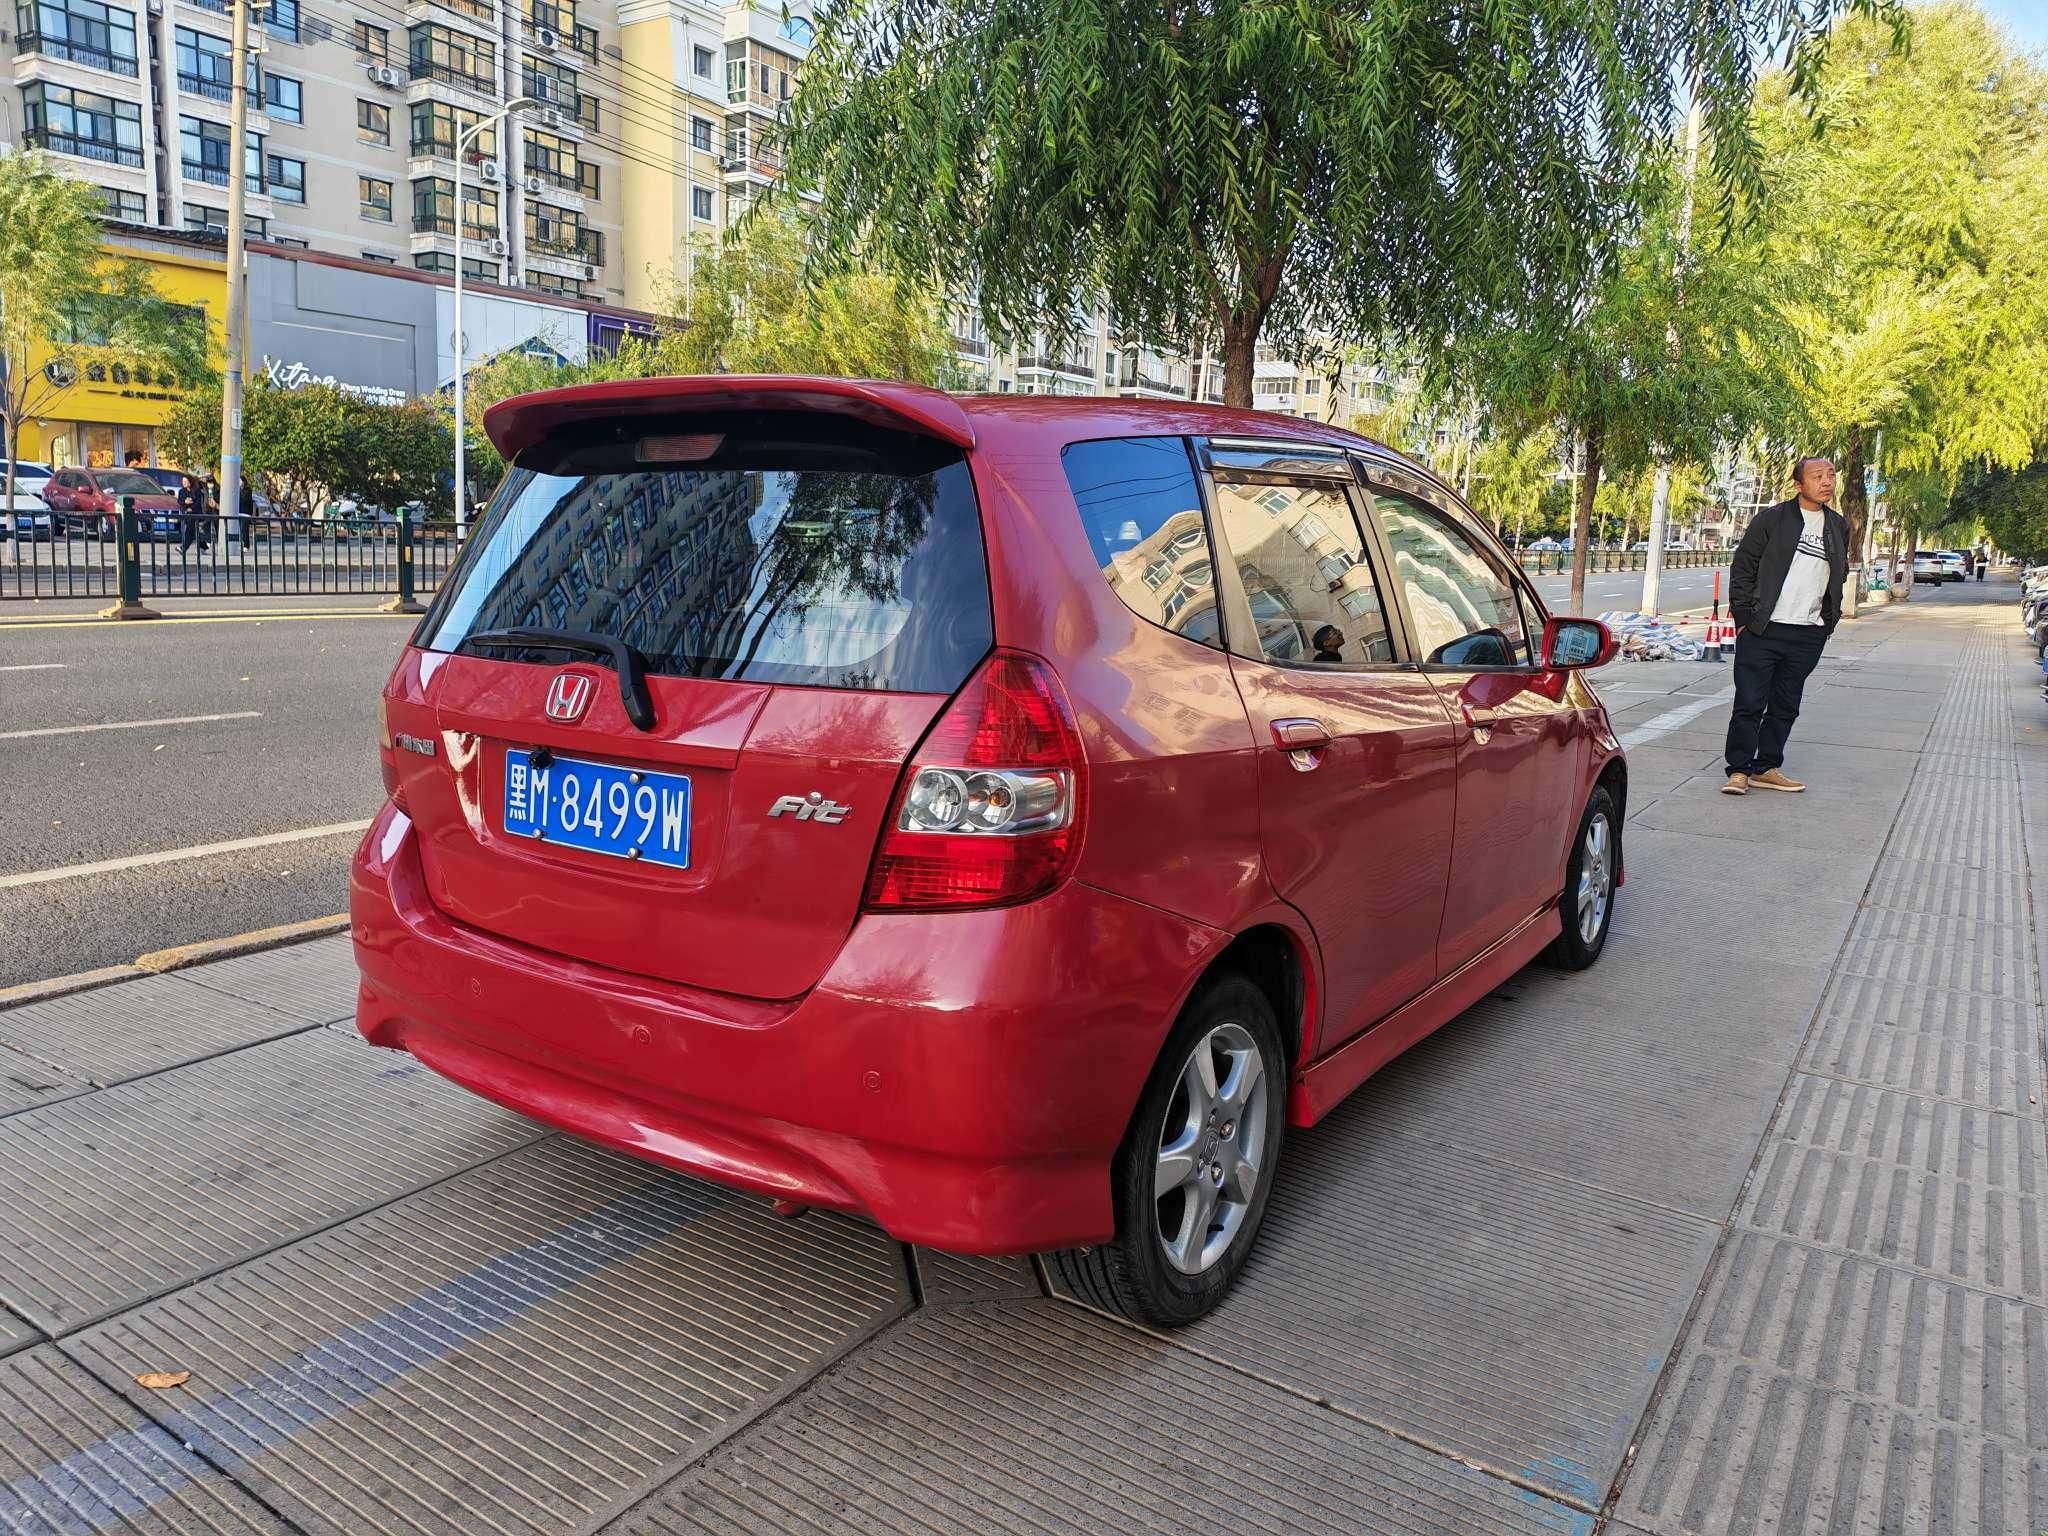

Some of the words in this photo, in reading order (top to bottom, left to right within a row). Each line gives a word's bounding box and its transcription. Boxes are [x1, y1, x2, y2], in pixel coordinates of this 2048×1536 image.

[361, 385, 388, 395] Wedding
[388, 388, 406, 397] Dress
[767, 792, 850, 825] Fit
